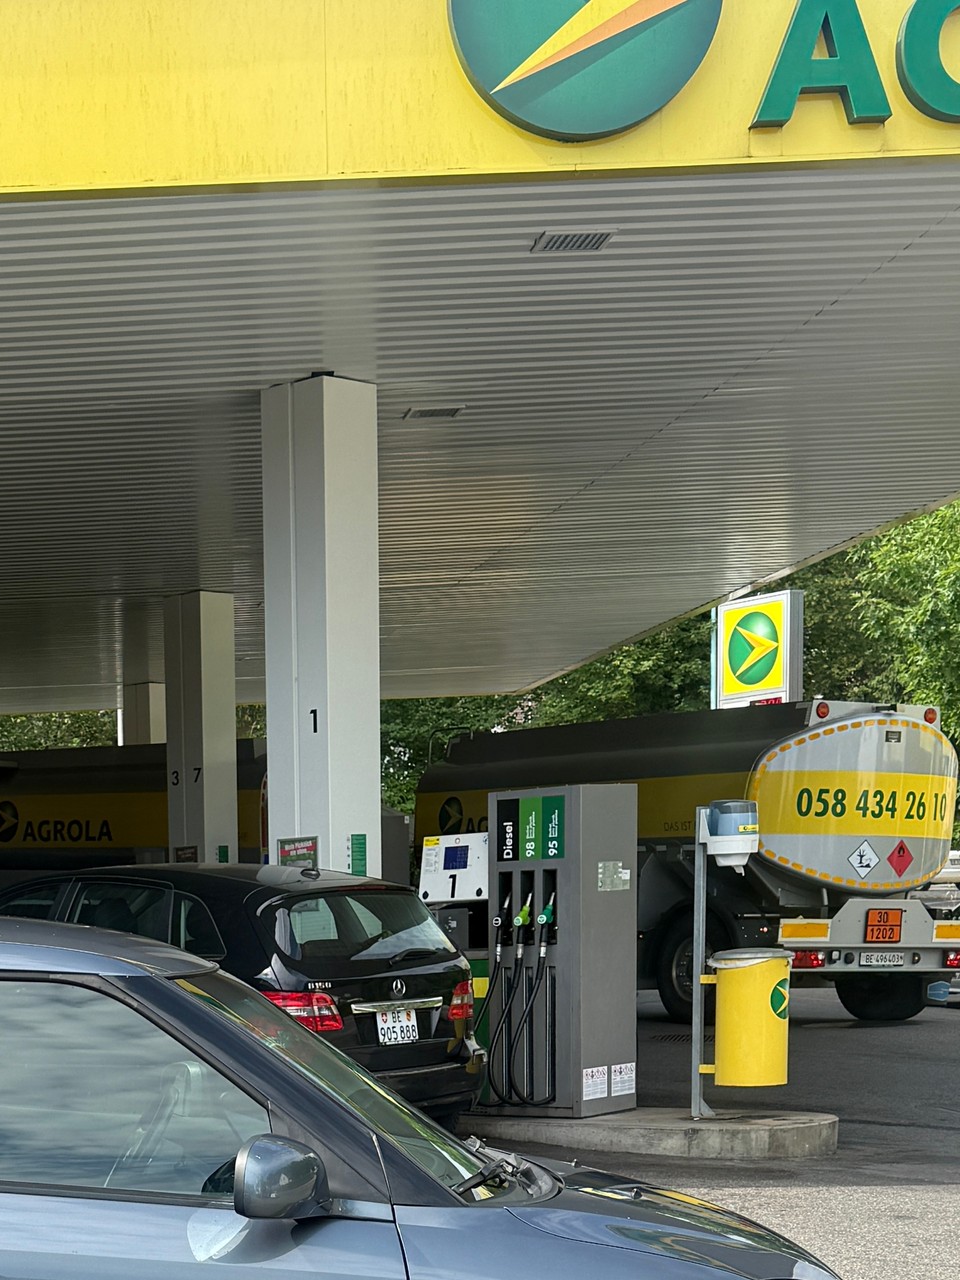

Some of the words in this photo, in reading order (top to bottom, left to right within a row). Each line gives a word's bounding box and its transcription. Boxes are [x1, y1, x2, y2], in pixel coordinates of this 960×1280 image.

[308, 708, 319, 734] 1
[171, 770, 180, 786] 3
[193, 767, 202, 783] 7
[796, 787, 847, 818] 058
[855, 789, 898, 819] 434
[904, 791, 926, 821] 26
[933, 792, 947, 822] 10
[22, 819, 113, 842] AGROLA
[663, 822, 679, 832] DAS
[680, 821, 692, 831] IST
[503, 821, 513, 859] Diesel
[525, 841, 535, 858] 98
[548, 840, 558, 857] 95
[448, 873, 458, 899] 1
[877, 911, 889, 924] 30
[865, 954, 874, 964] BE
[391, 1011, 403, 1023] BE
[380, 1026, 399, 1041] 905
[400, 1025, 417, 1039] 888
